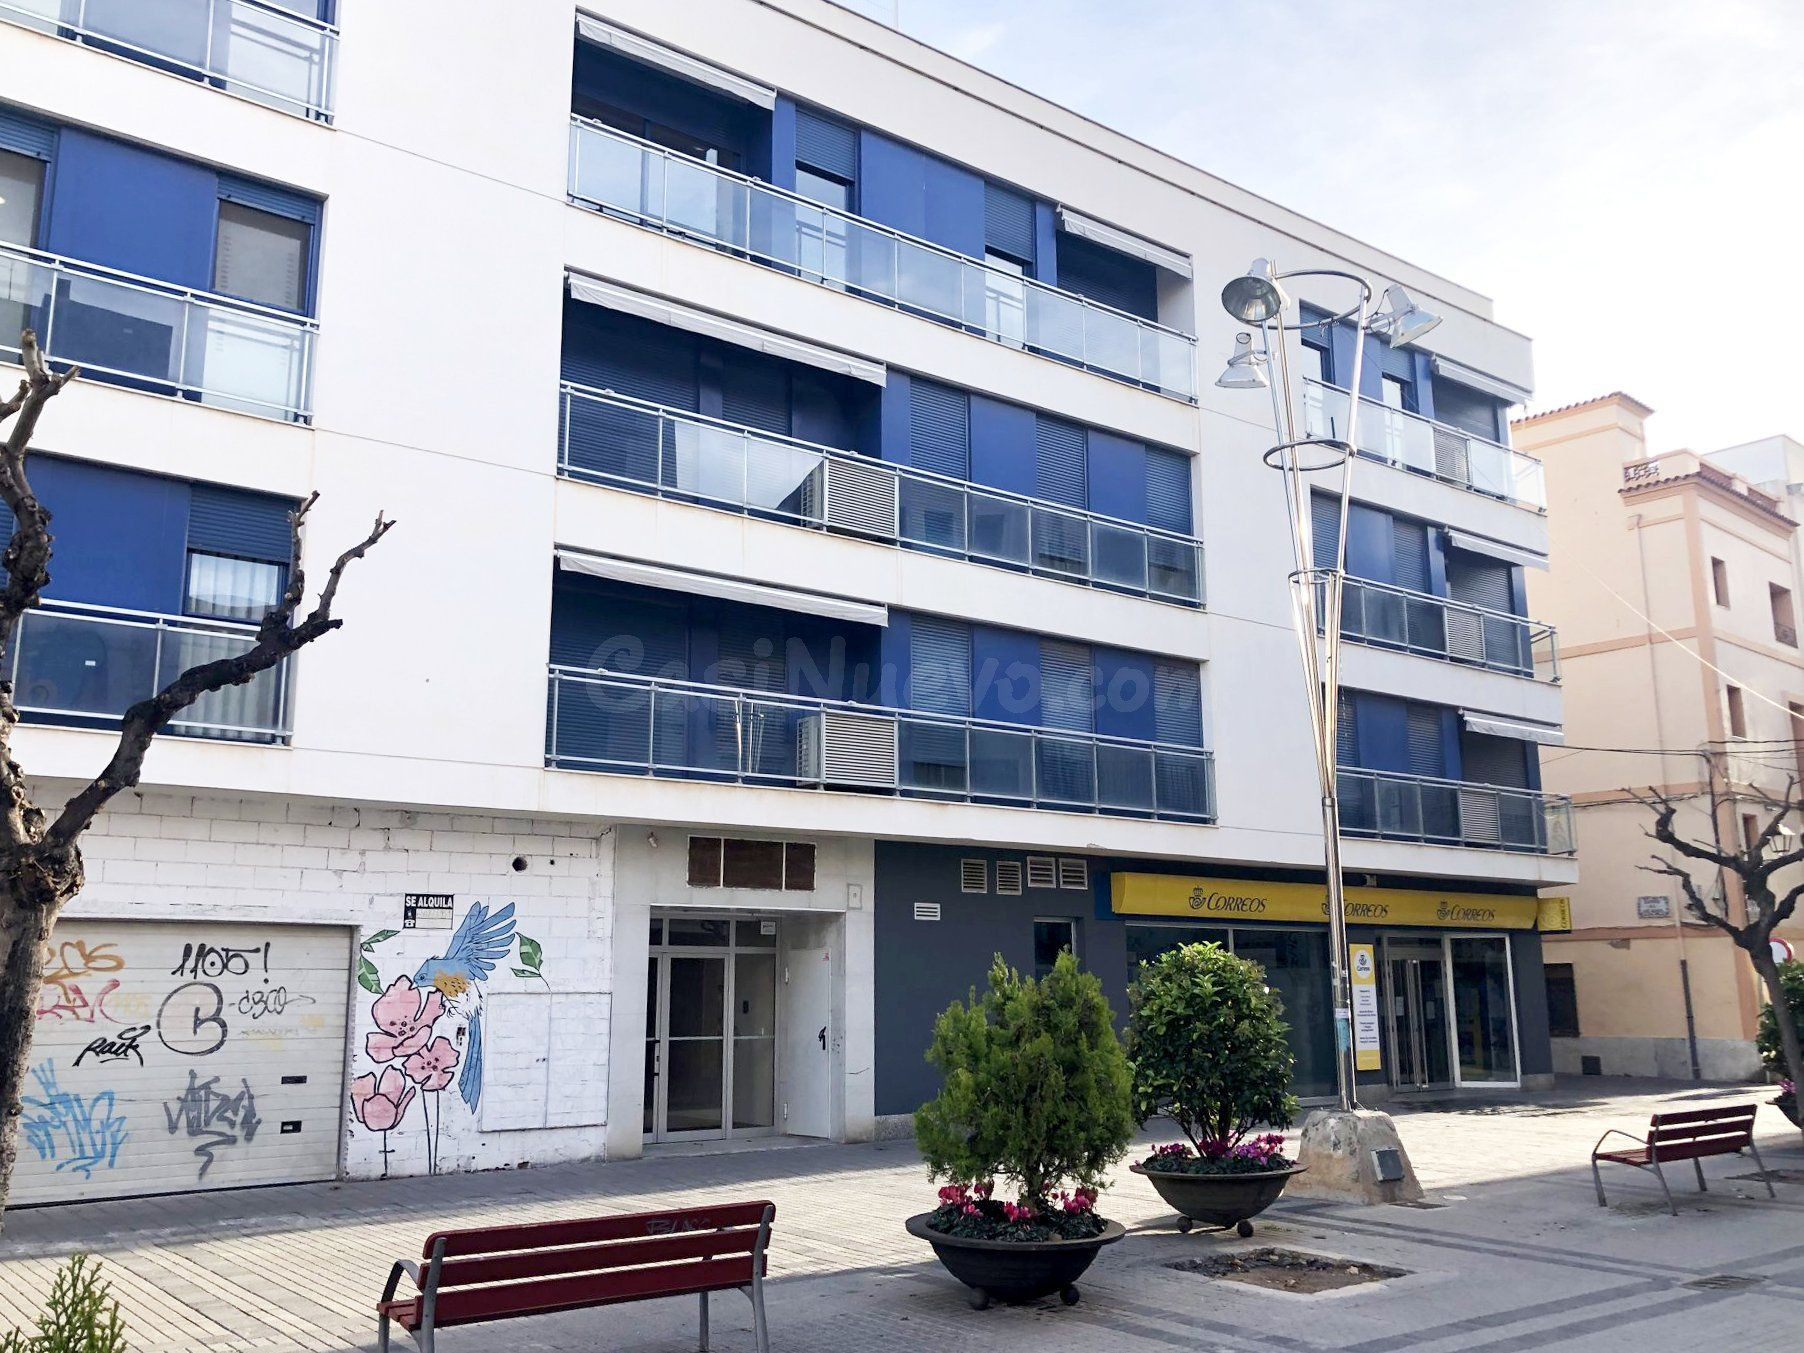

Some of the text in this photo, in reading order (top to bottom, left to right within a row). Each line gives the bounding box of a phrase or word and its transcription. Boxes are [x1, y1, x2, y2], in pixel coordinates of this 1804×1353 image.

[405, 895, 453, 908] SE ALQUILA
[1207, 892, 1267, 913] CORREOS
[1343, 899, 1389, 918] ORREOS
